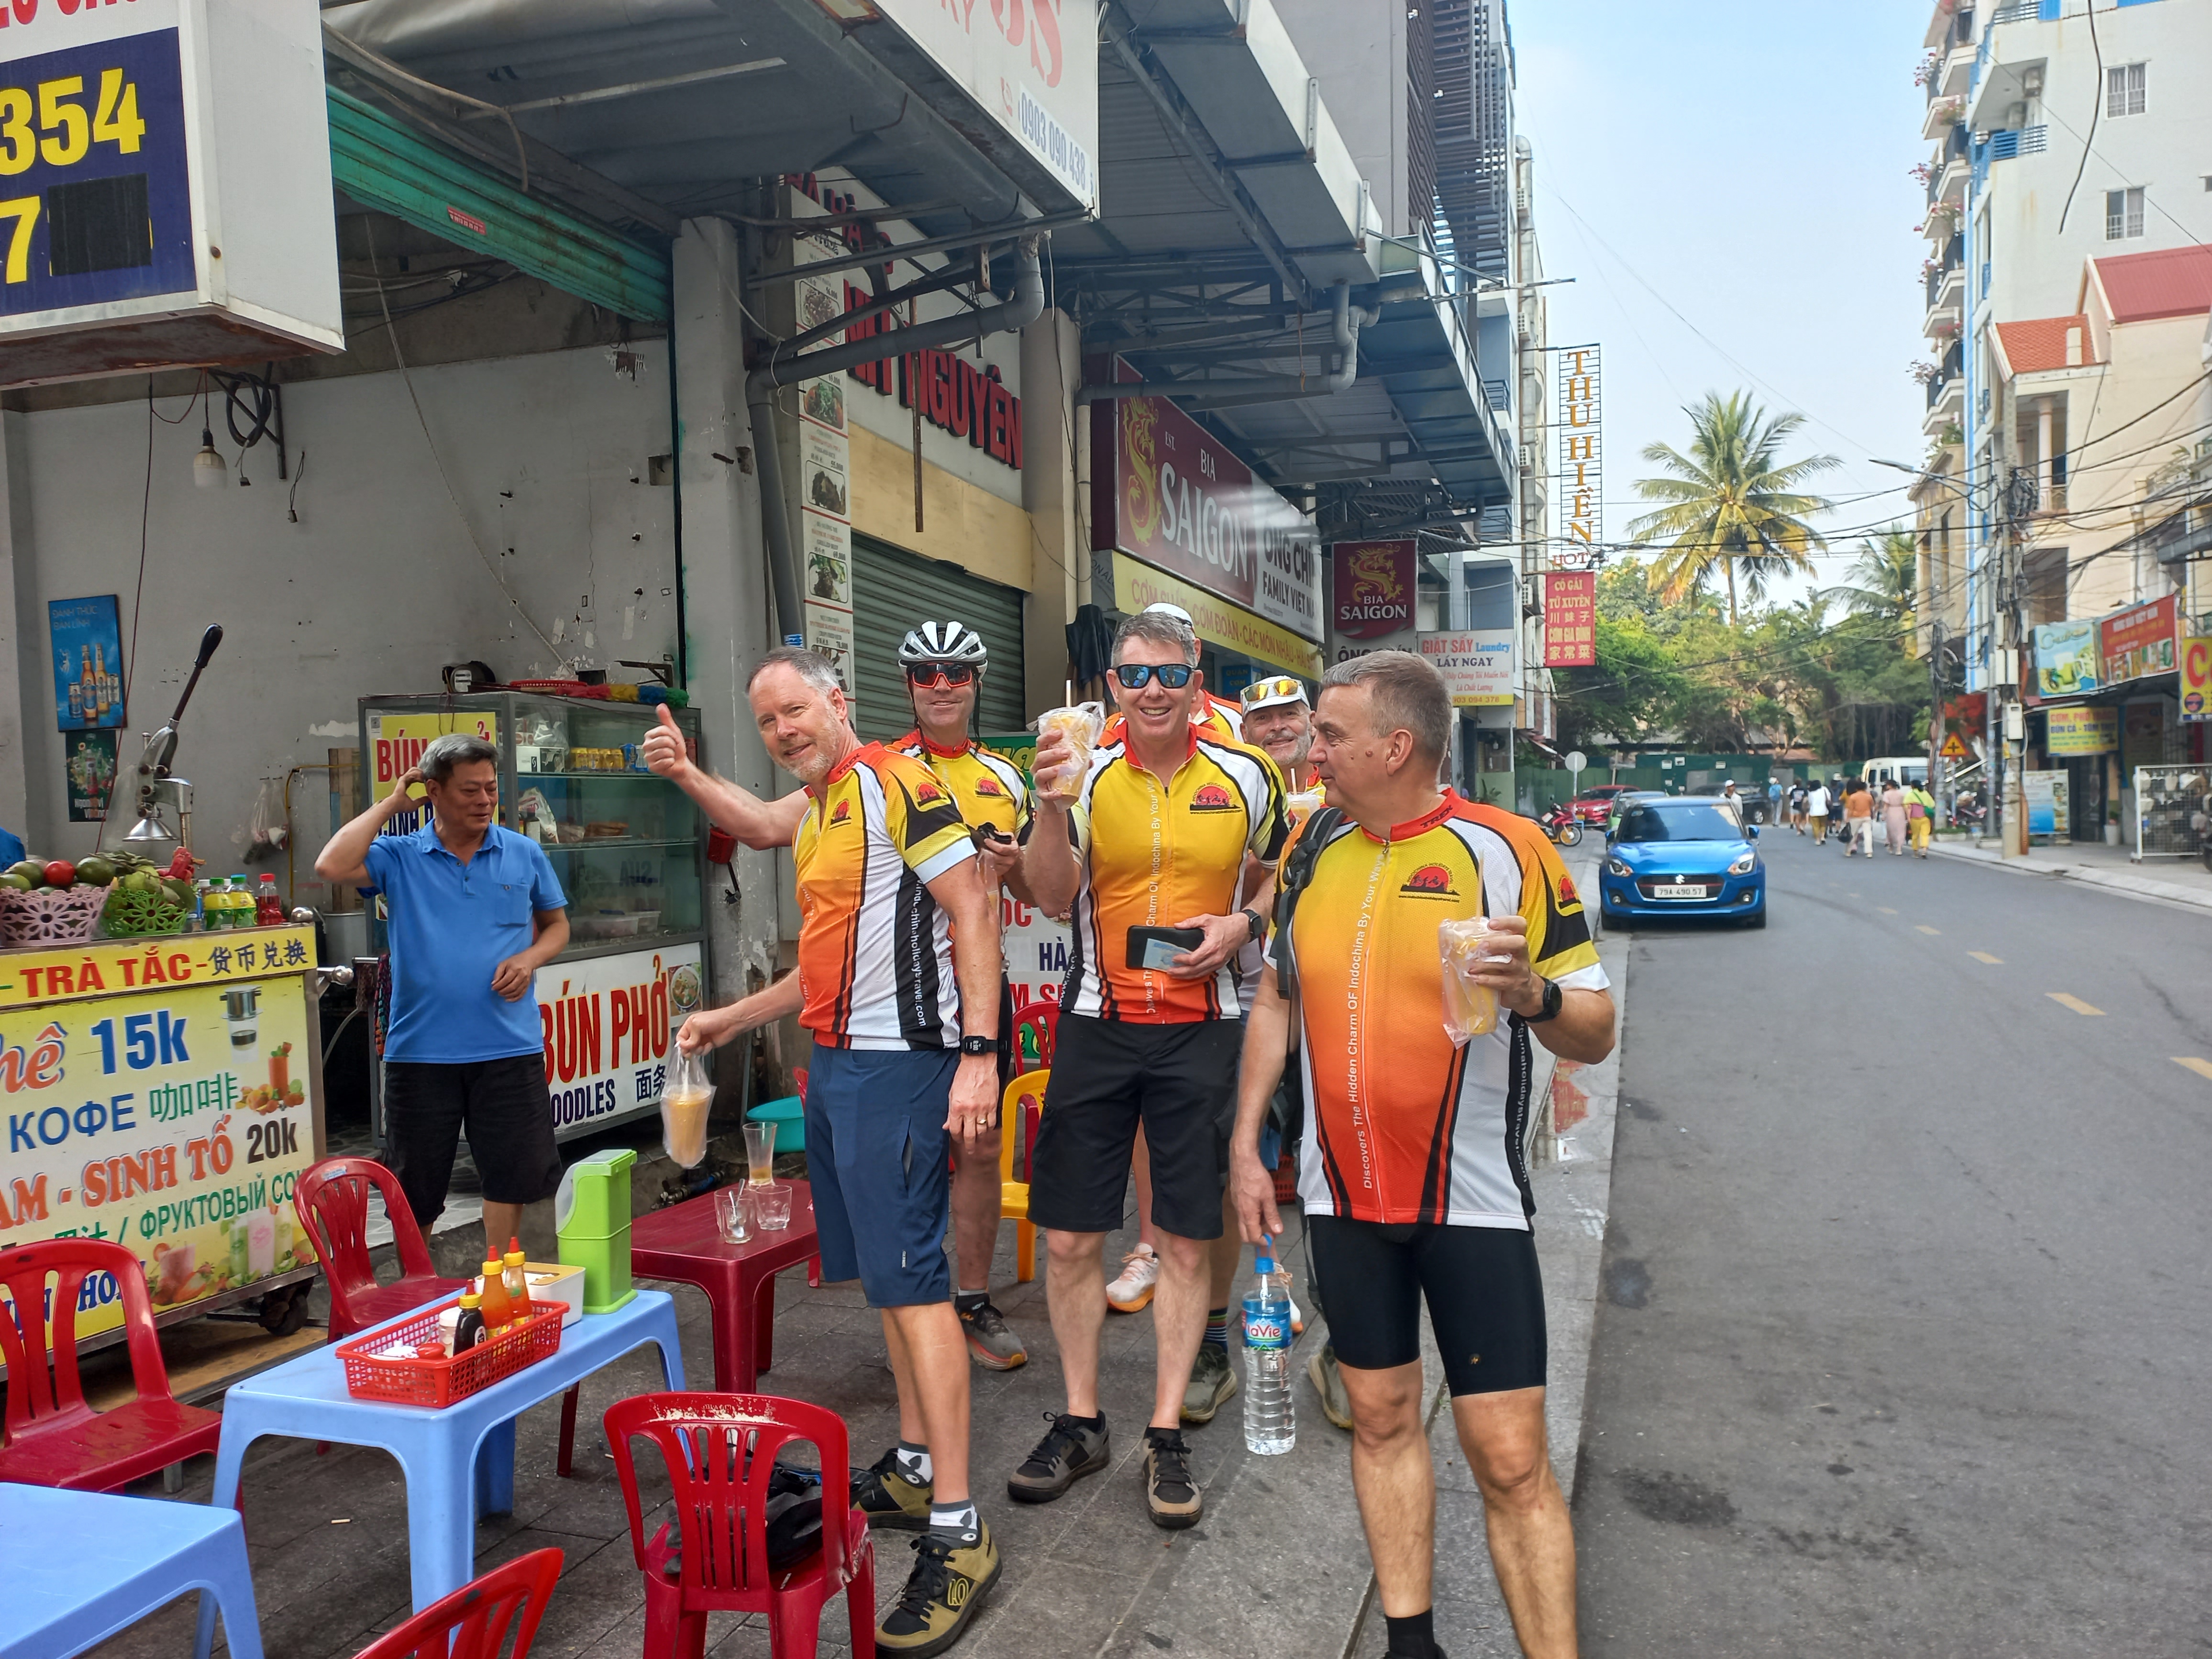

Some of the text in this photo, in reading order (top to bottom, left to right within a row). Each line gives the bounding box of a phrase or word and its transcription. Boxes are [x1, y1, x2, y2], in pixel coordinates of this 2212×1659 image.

[1021, 92, 1085, 191] 0903 090 438
[1566, 350, 1593, 427] THU
[1201, 448, 1216, 481] BIA
[1161, 462, 1248, 582] SAIGON
[1263, 570, 1290, 607] FAMILY
[1363, 595, 1384, 605] BIA
[1340, 604, 1407, 620] SAIGON
[1462, 657, 1493, 667] NGAY
[838, 752, 861, 775] TREK
[1150, 795, 1159, 815] Your
[1151, 818, 1162, 829] By
[1420, 804, 1453, 829] TREK
[1151, 830, 1161, 876] Indochina
[1146, 896, 1158, 927] Charm
[1360, 885, 1376, 909] Your
[1358, 912, 1371, 928] By
[20, 957, 105, 998] TRÀ
[117, 945, 192, 987] TẮC
[1349, 931, 1365, 989] Indochina
[610, 954, 669, 1070] PHỞ
[91, 1008, 190, 1075] 15k
[1348, 1014, 1358, 1055] Charm
[149, 1072, 239, 1122] 咖啡
[1348, 1059, 1359, 1103] Hidden
[9, 1093, 136, 1154] КОФЕ
[1351, 1106, 1363, 1128] The
[81, 1144, 177, 1208] SINH
[246, 1117, 298, 1164] 20k
[1356, 1130, 1373, 1189] Discovers
[139, 1172, 266, 1240] ФРУКТОВЫЙ
[1248, 1324, 1281, 1338] laVie
